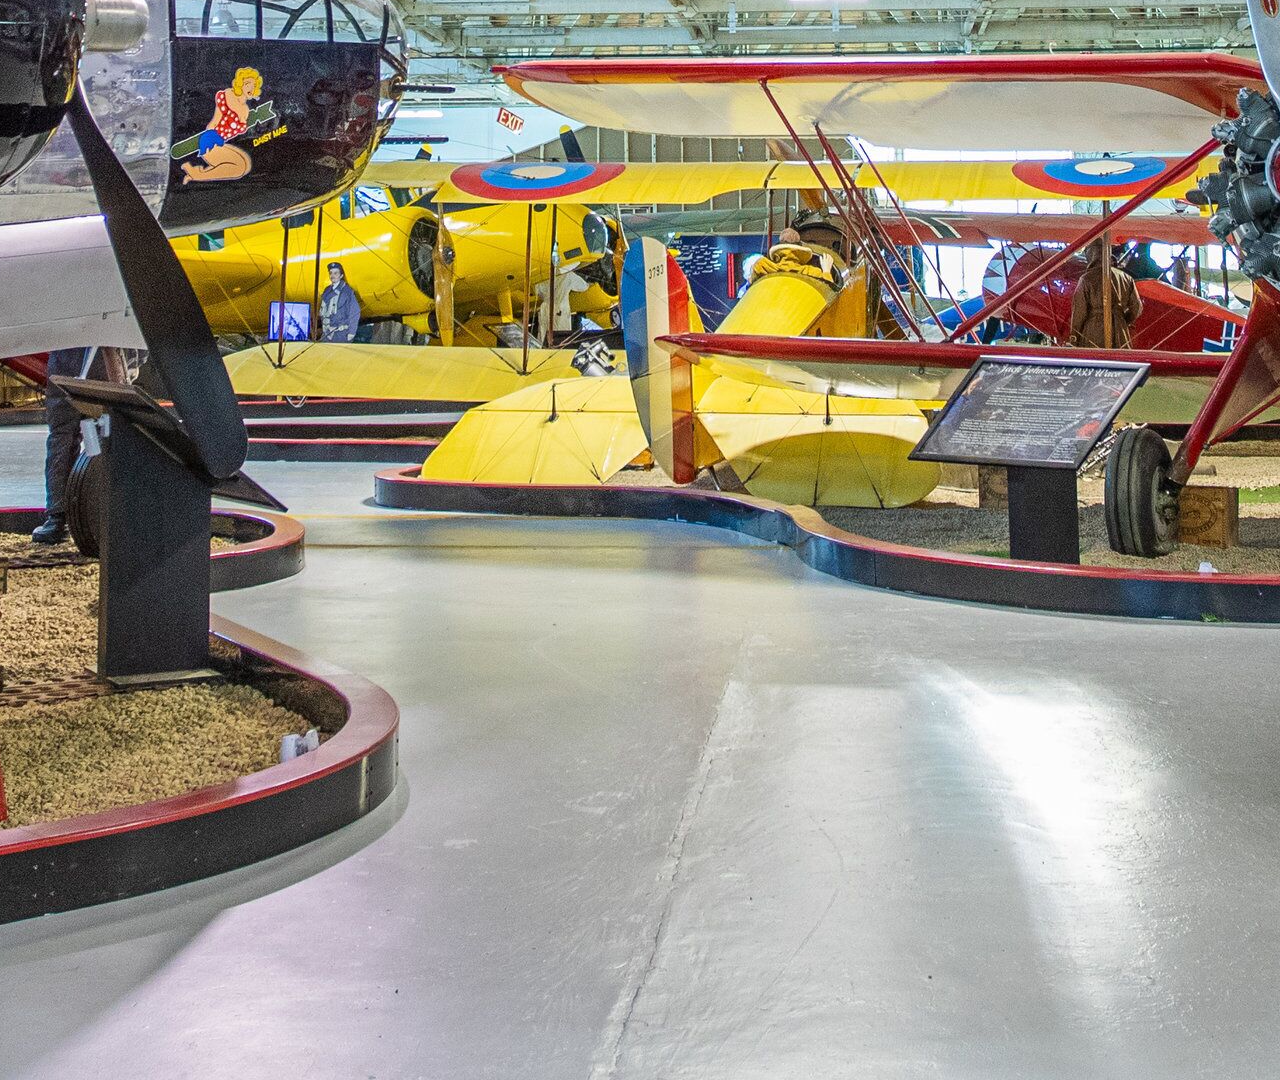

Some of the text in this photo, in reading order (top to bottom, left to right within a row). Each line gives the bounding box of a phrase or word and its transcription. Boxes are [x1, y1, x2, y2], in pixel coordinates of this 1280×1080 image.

[499, 108, 524, 131] EXIT
[252, 124, 288, 147] DAISY MAE
[998, 364, 1023, 377] Jack
[1020, 365, 1069, 376] Johnson's
